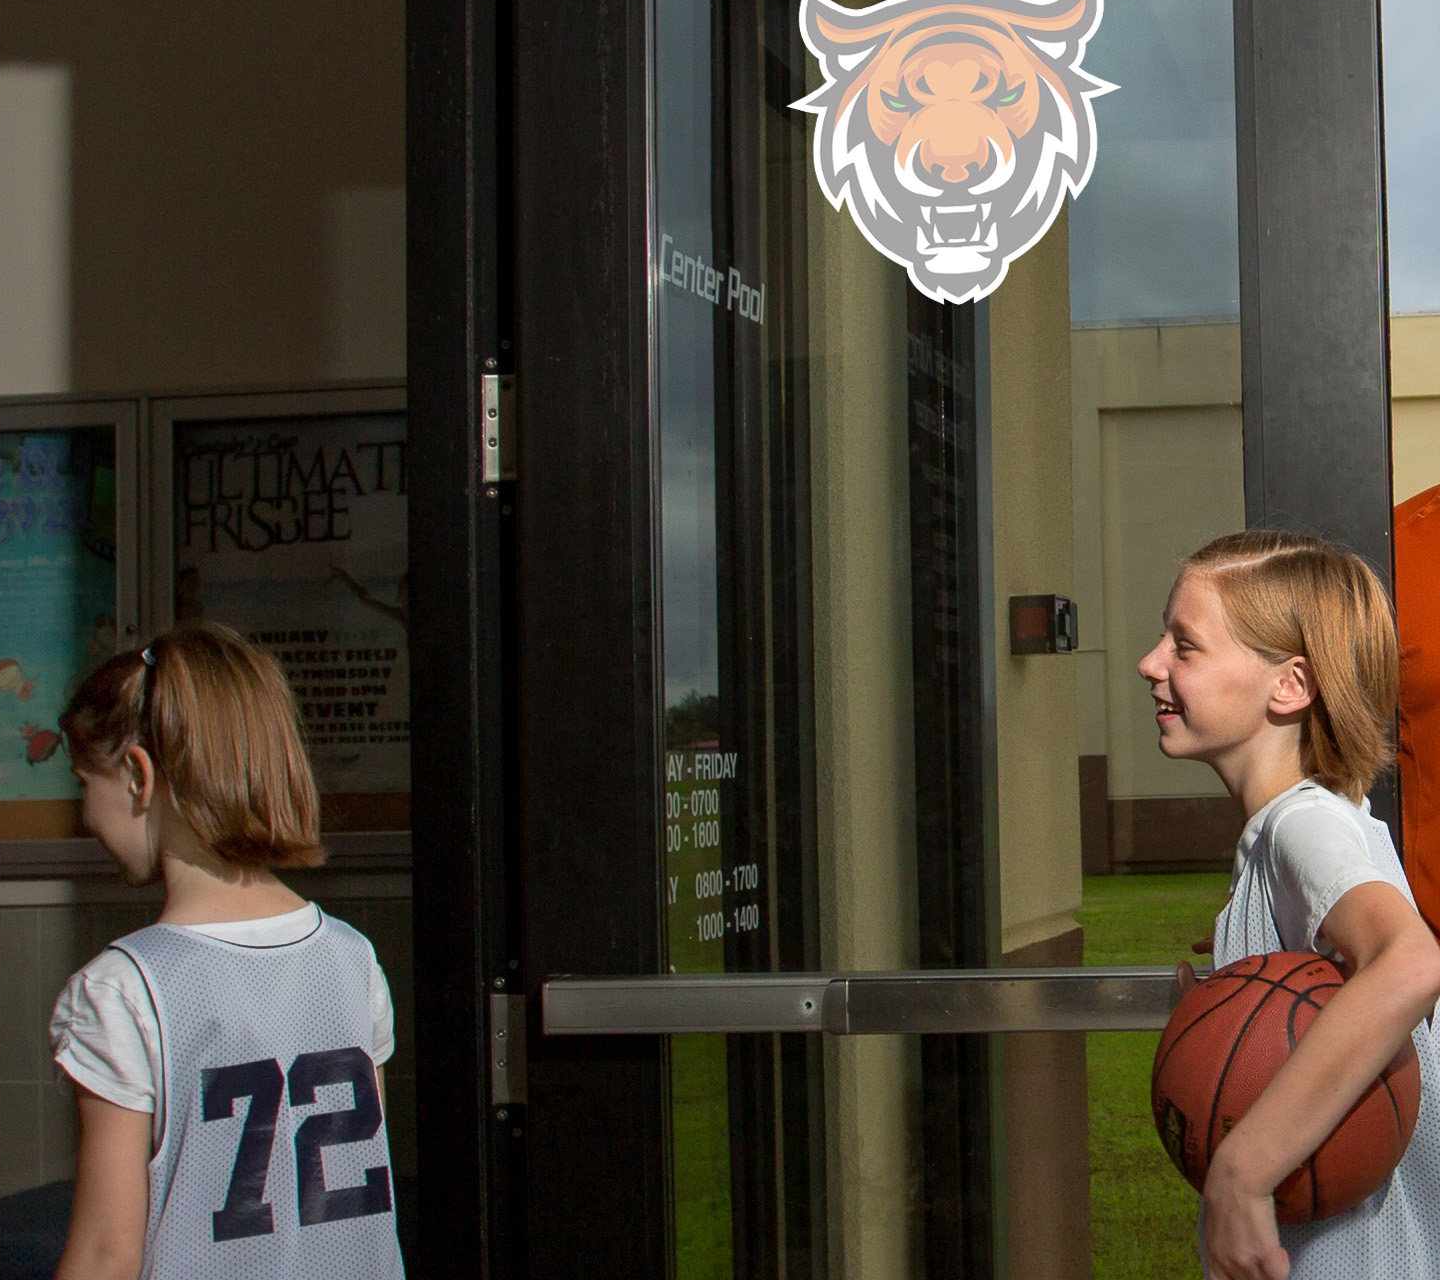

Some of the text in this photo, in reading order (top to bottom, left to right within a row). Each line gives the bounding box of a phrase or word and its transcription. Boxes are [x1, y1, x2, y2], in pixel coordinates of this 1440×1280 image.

[660, 233, 766, 325] Center Pool
[185, 489, 352, 552] FRISBEE
[248, 630, 328, 645] ANUARY
[273, 648, 398, 665] ACKET FIELD
[302, 701, 379, 719] EVENT
[668, 753, 684, 782] AY
[695, 752, 738, 780] FRIDAY
[691, 789, 719, 817] 0700
[695, 869, 723, 899] 0800
[733, 863, 758, 891] 1700
[697, 911, 724, 942] 1000
[734, 904, 759, 933] 1400
[200, 1046, 393, 1243] 72
